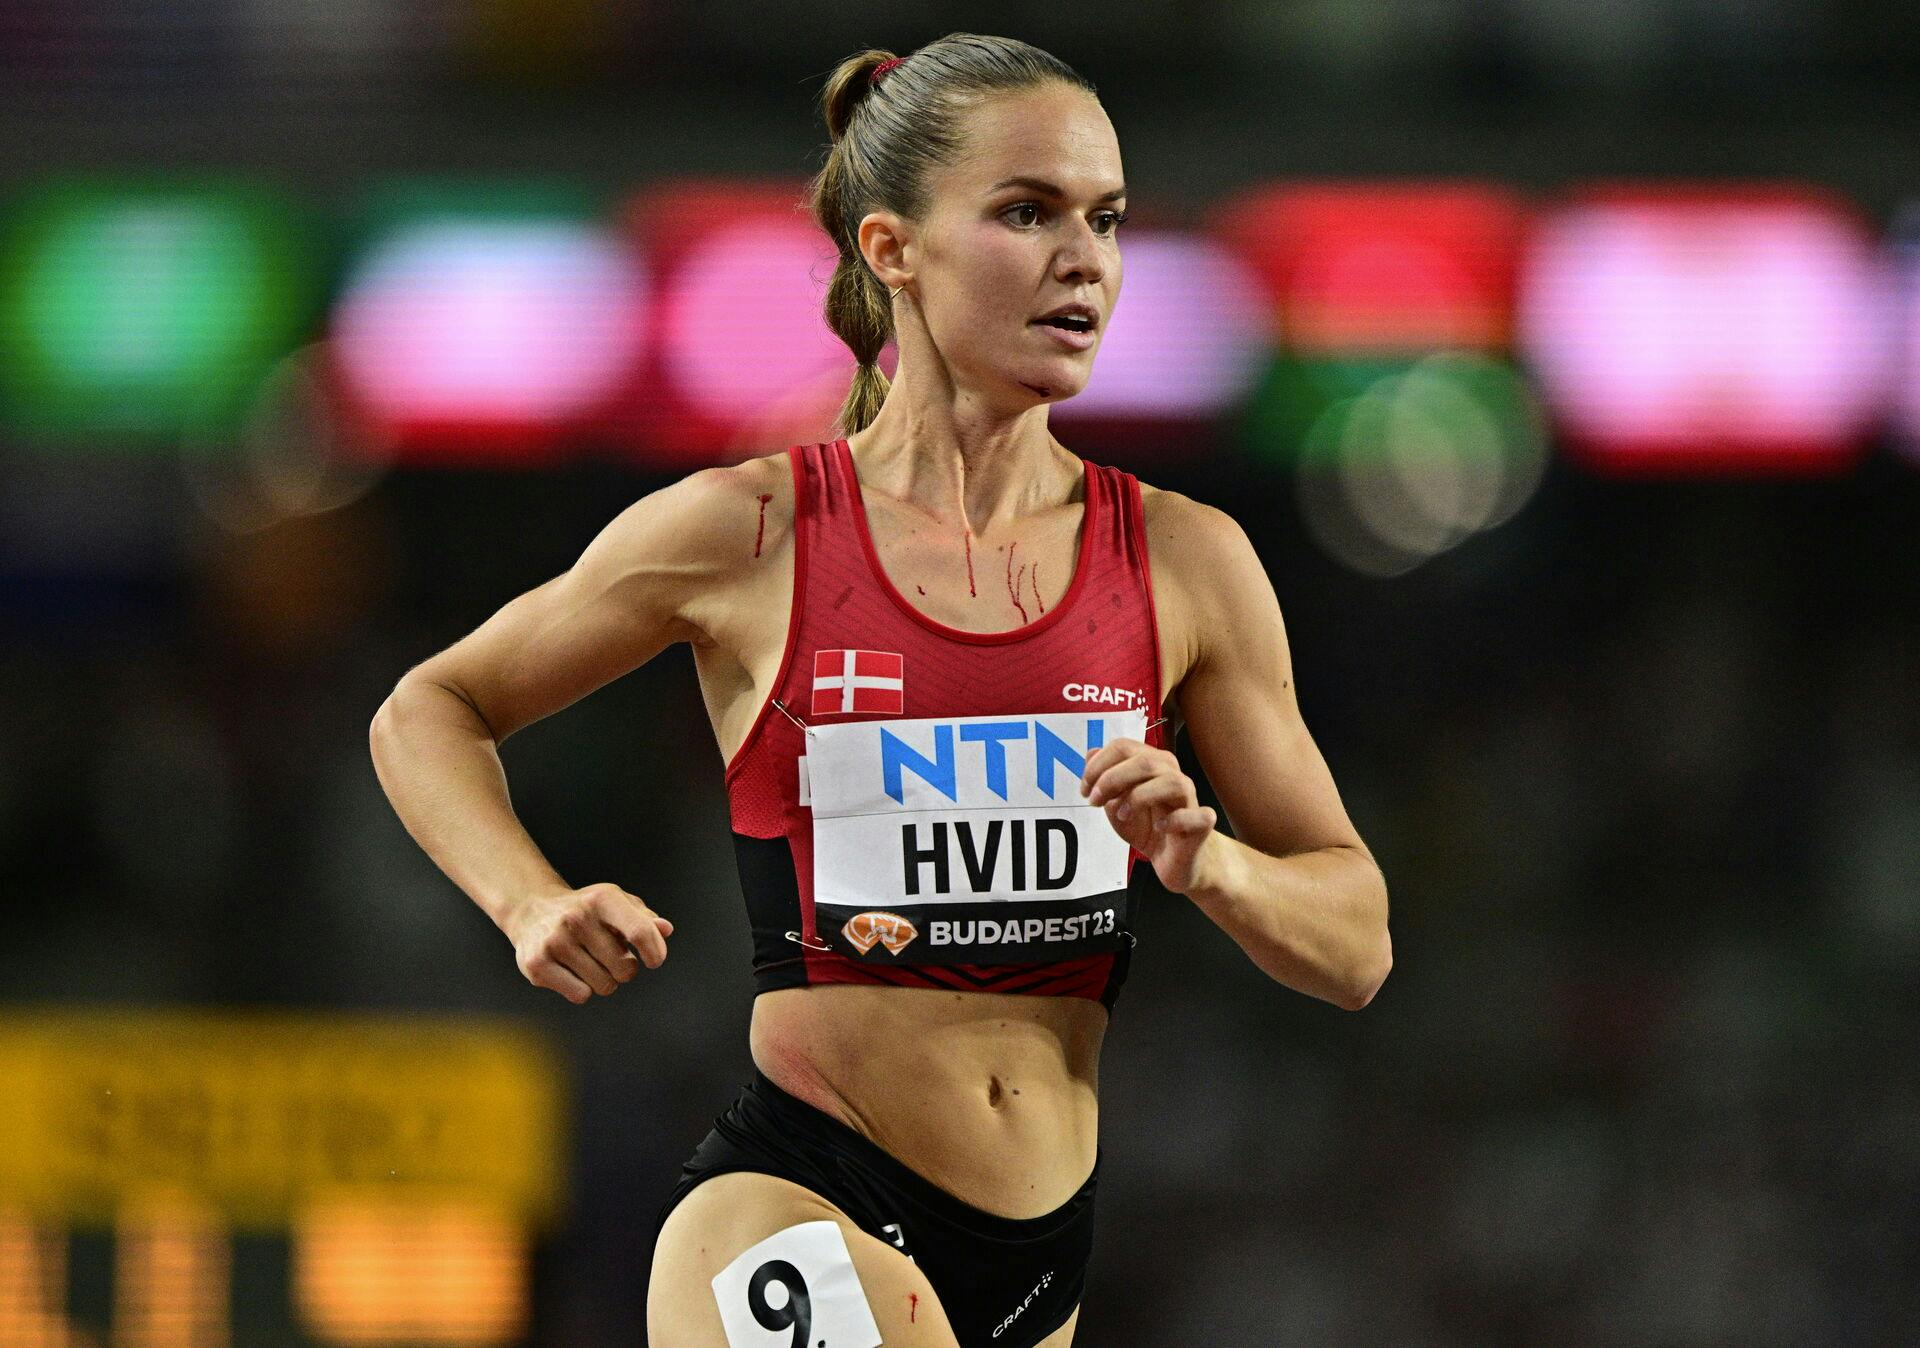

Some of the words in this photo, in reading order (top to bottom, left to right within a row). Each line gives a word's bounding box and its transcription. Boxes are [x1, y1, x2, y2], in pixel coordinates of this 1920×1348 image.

[1062, 683, 1136, 709] CRAFT
[880, 719, 1104, 805] NTN
[902, 818, 1079, 896] HVID
[929, 914, 1091, 946] BUDAPEST
[1092, 908, 1115, 936] 23
[992, 1283, 1041, 1338] CRAFT
